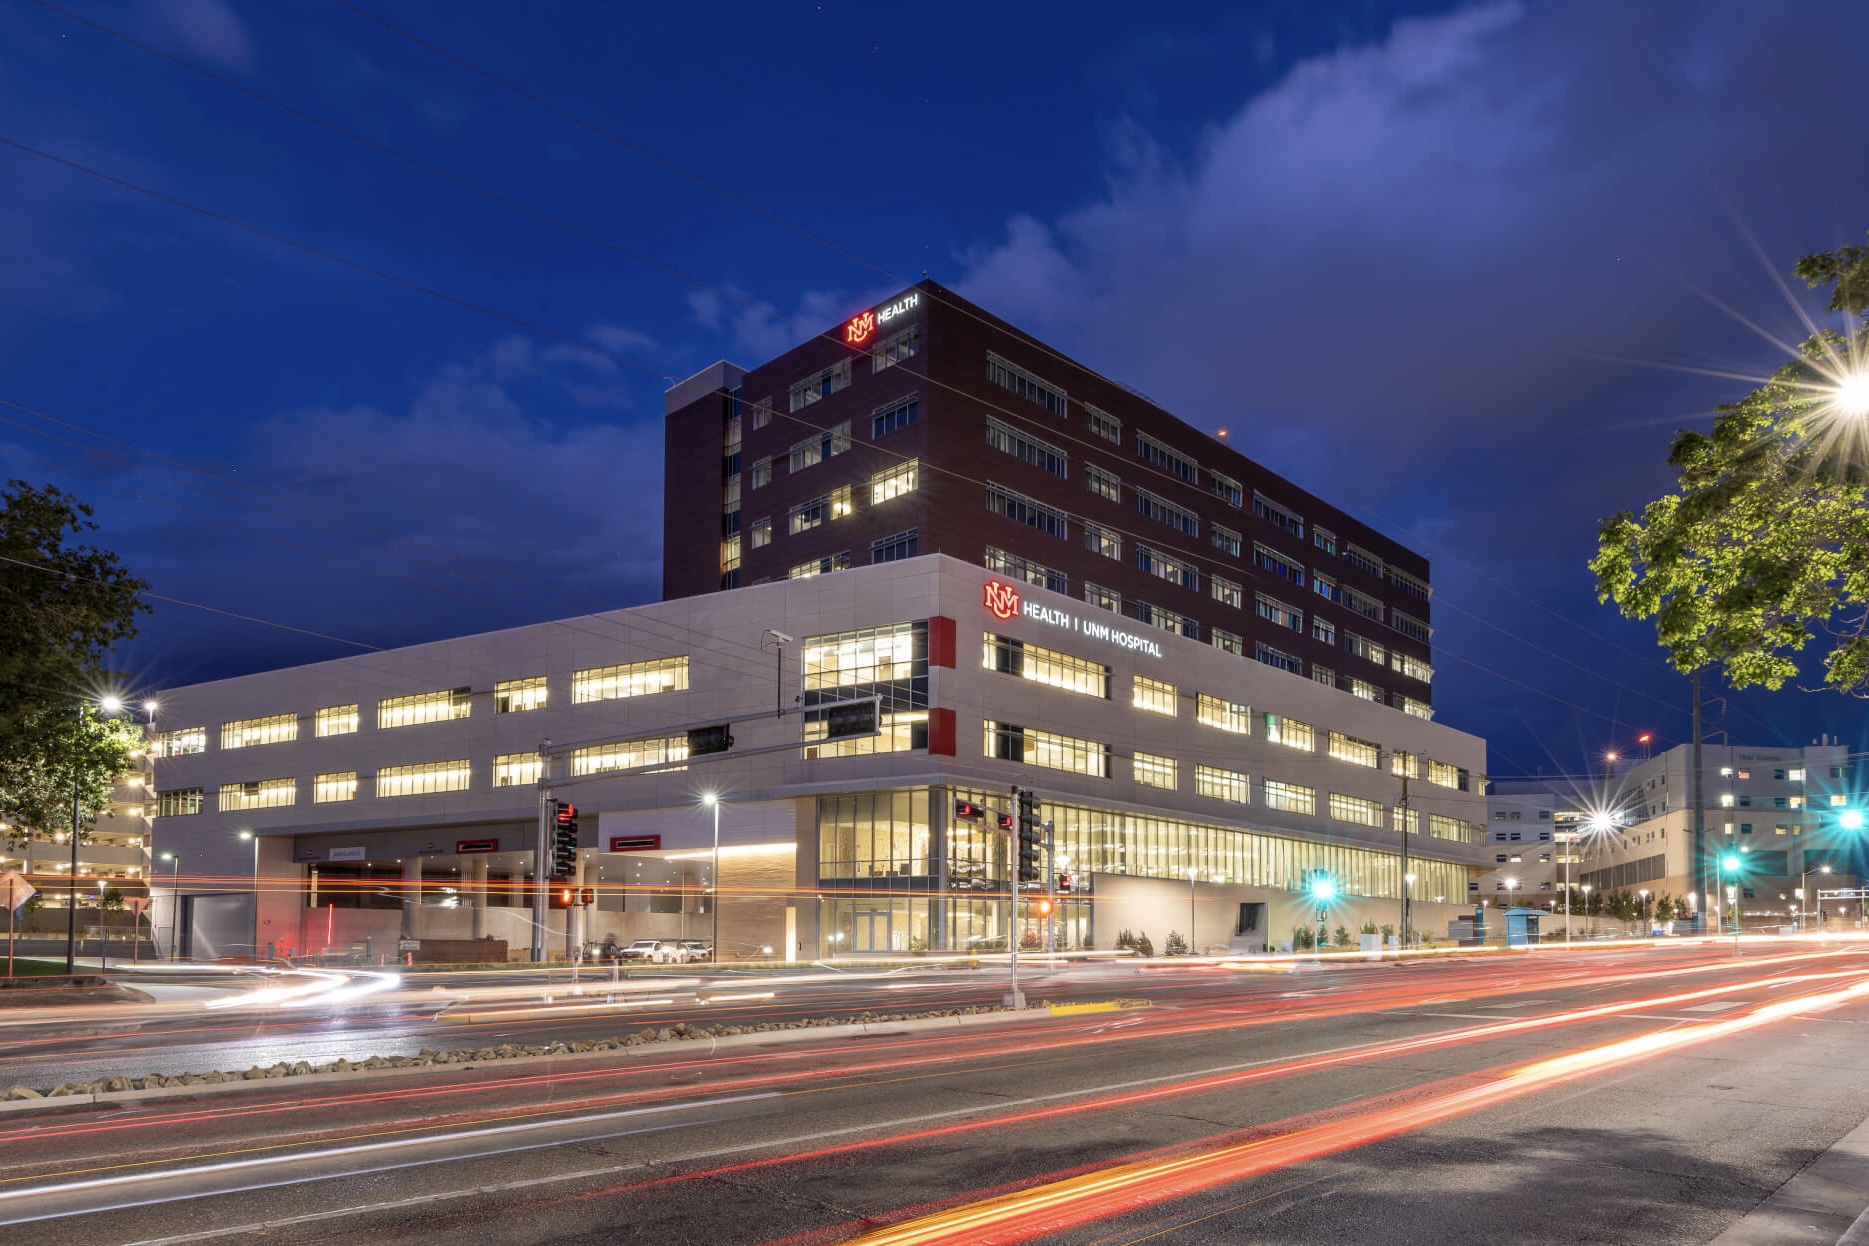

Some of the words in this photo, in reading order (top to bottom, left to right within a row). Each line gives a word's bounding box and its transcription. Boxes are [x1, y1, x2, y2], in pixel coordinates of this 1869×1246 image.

[877, 293, 918, 325] HEALTH
[1023, 601, 1069, 629] HEALTH
[1083, 620, 1109, 641] UNM
[1111, 628, 1162, 658] HOSPITAL
